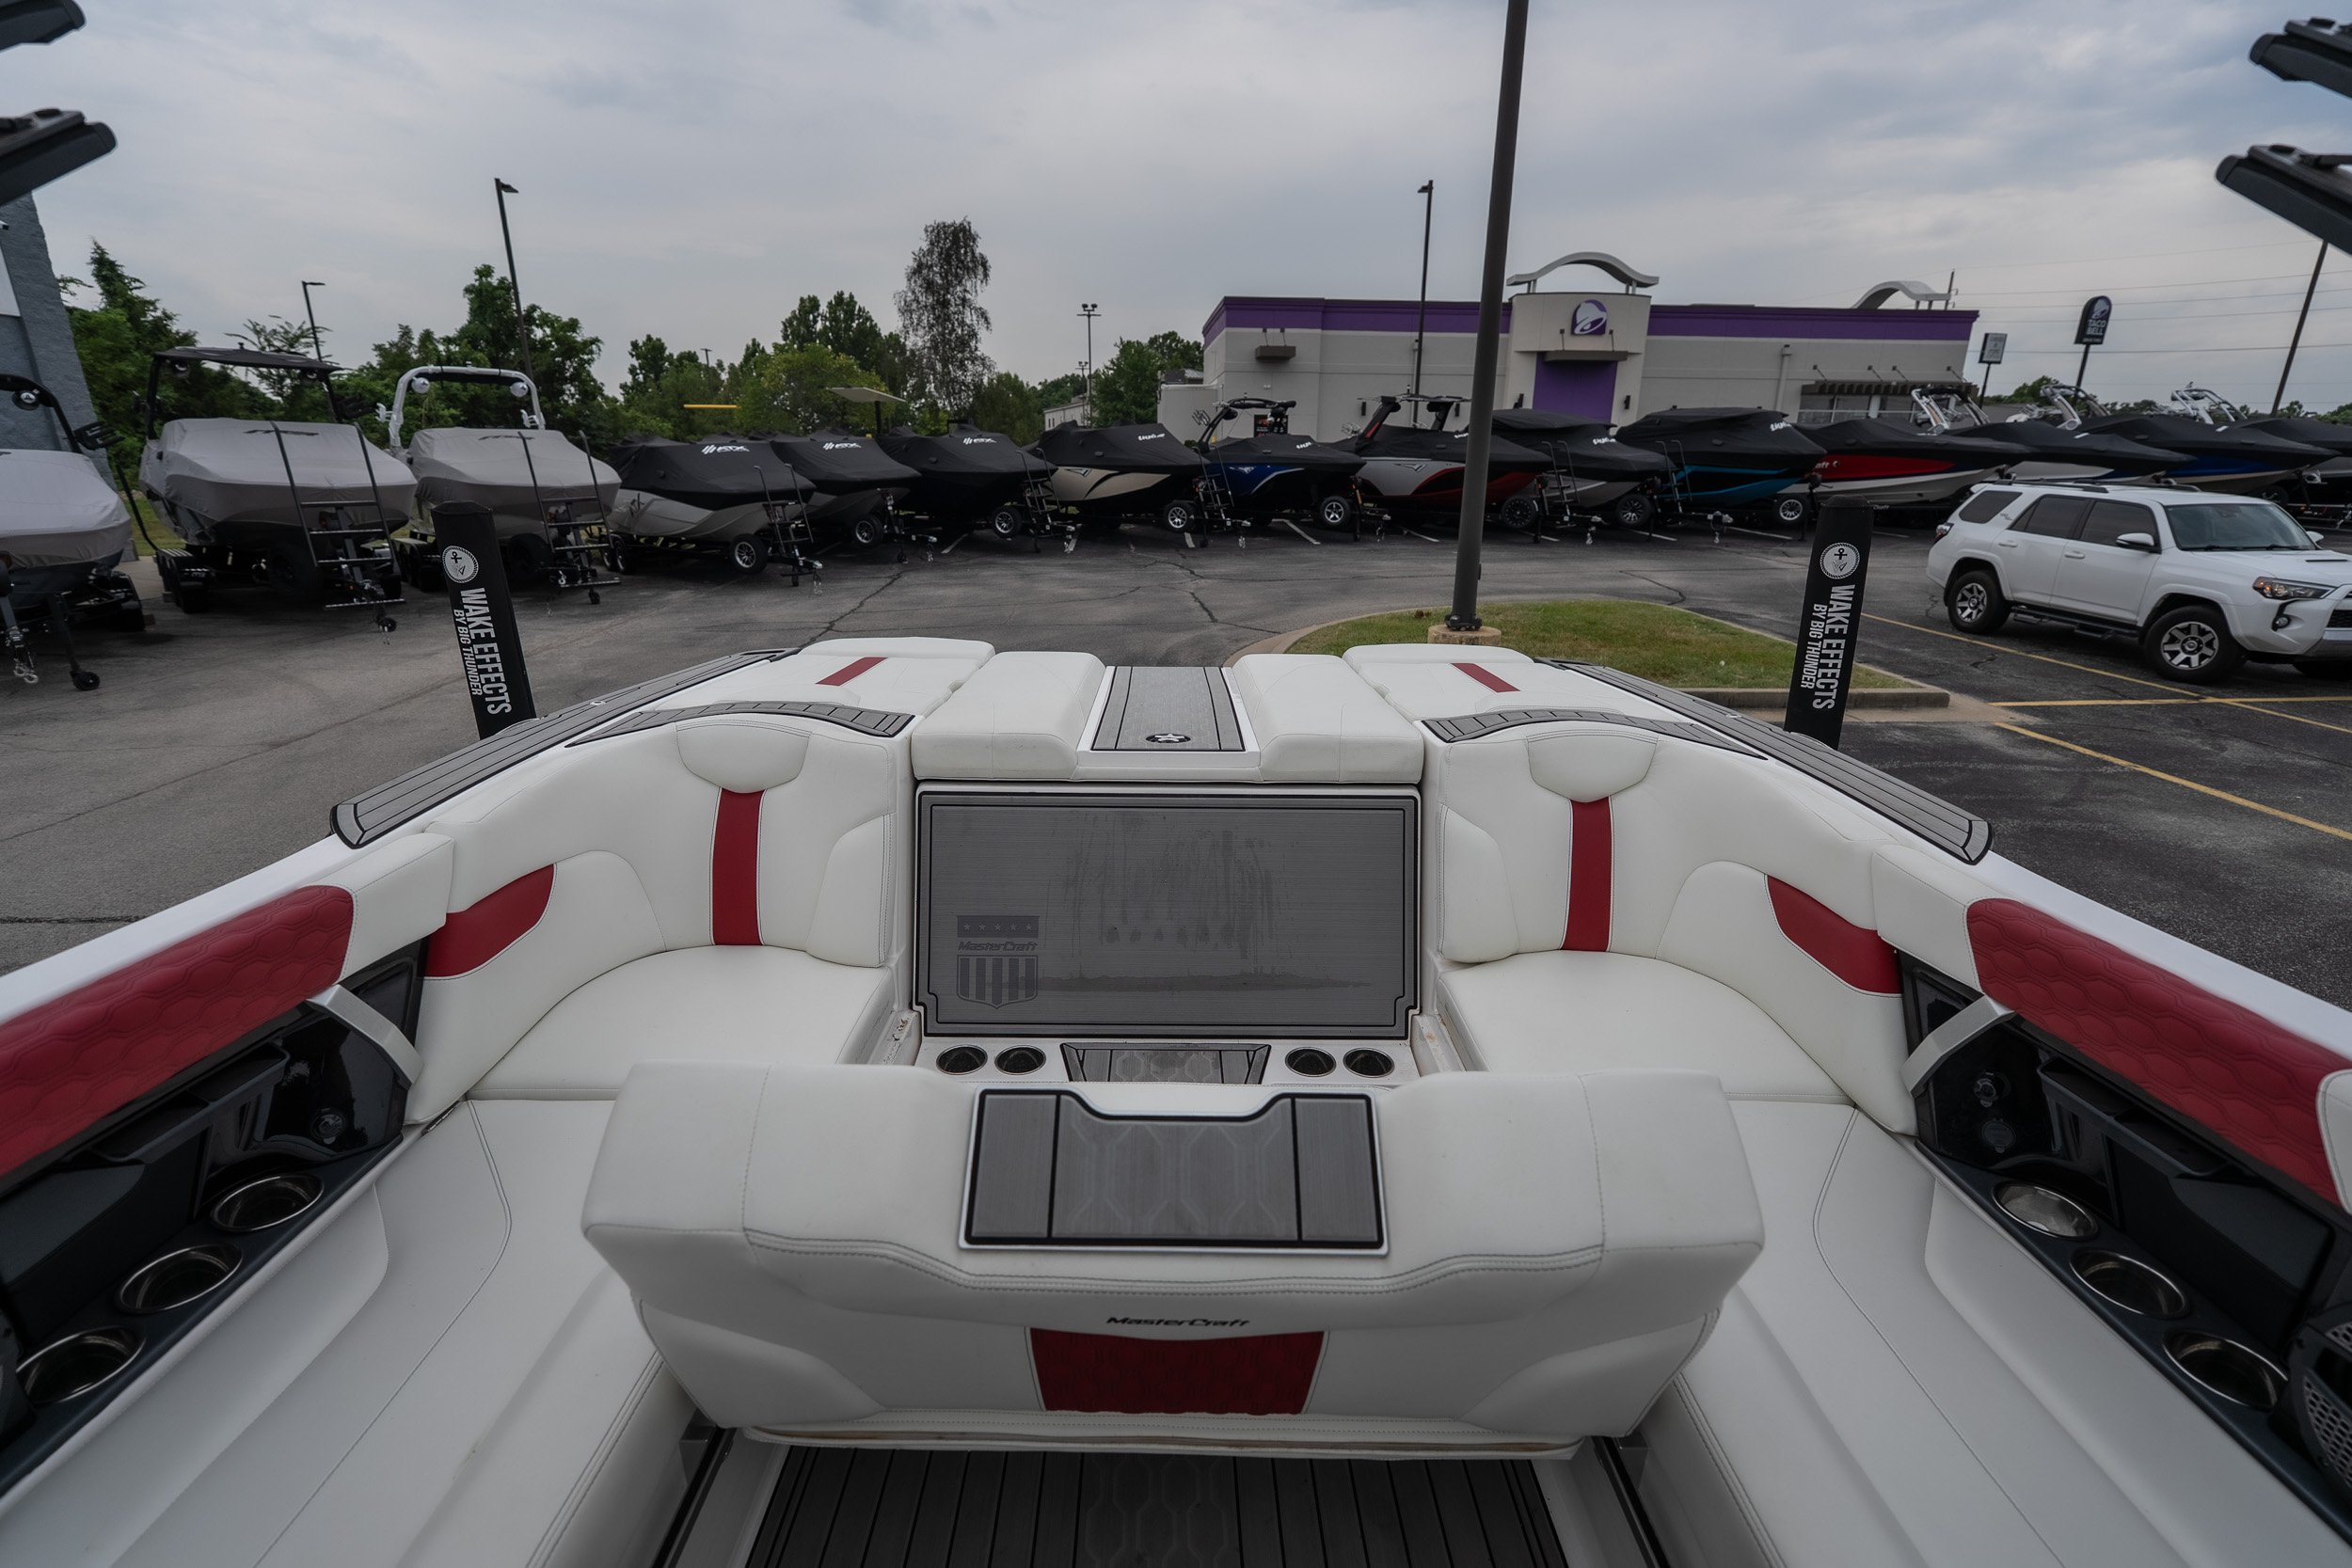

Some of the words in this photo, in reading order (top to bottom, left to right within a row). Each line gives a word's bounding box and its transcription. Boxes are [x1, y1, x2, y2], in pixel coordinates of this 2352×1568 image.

[2088, 319, 2107, 328] TACO
[453, 609, 468, 625] BY
[460, 587, 496, 640] WAKE
[1812, 603, 1828, 620] BY
[1824, 584, 1855, 635] WAKE
[457, 626, 471, 644] BIG
[1808, 621, 1825, 640] BIG
[462, 646, 483, 696] THUNDER
[1801, 641, 1822, 689] THUNDER
[1812, 639, 1846, 709] EFFECTS
[472, 642, 512, 715] EFFECTS
[958, 941, 1038, 952] MasterCraft
[1106, 1317, 1249, 1327] MasterCraft
